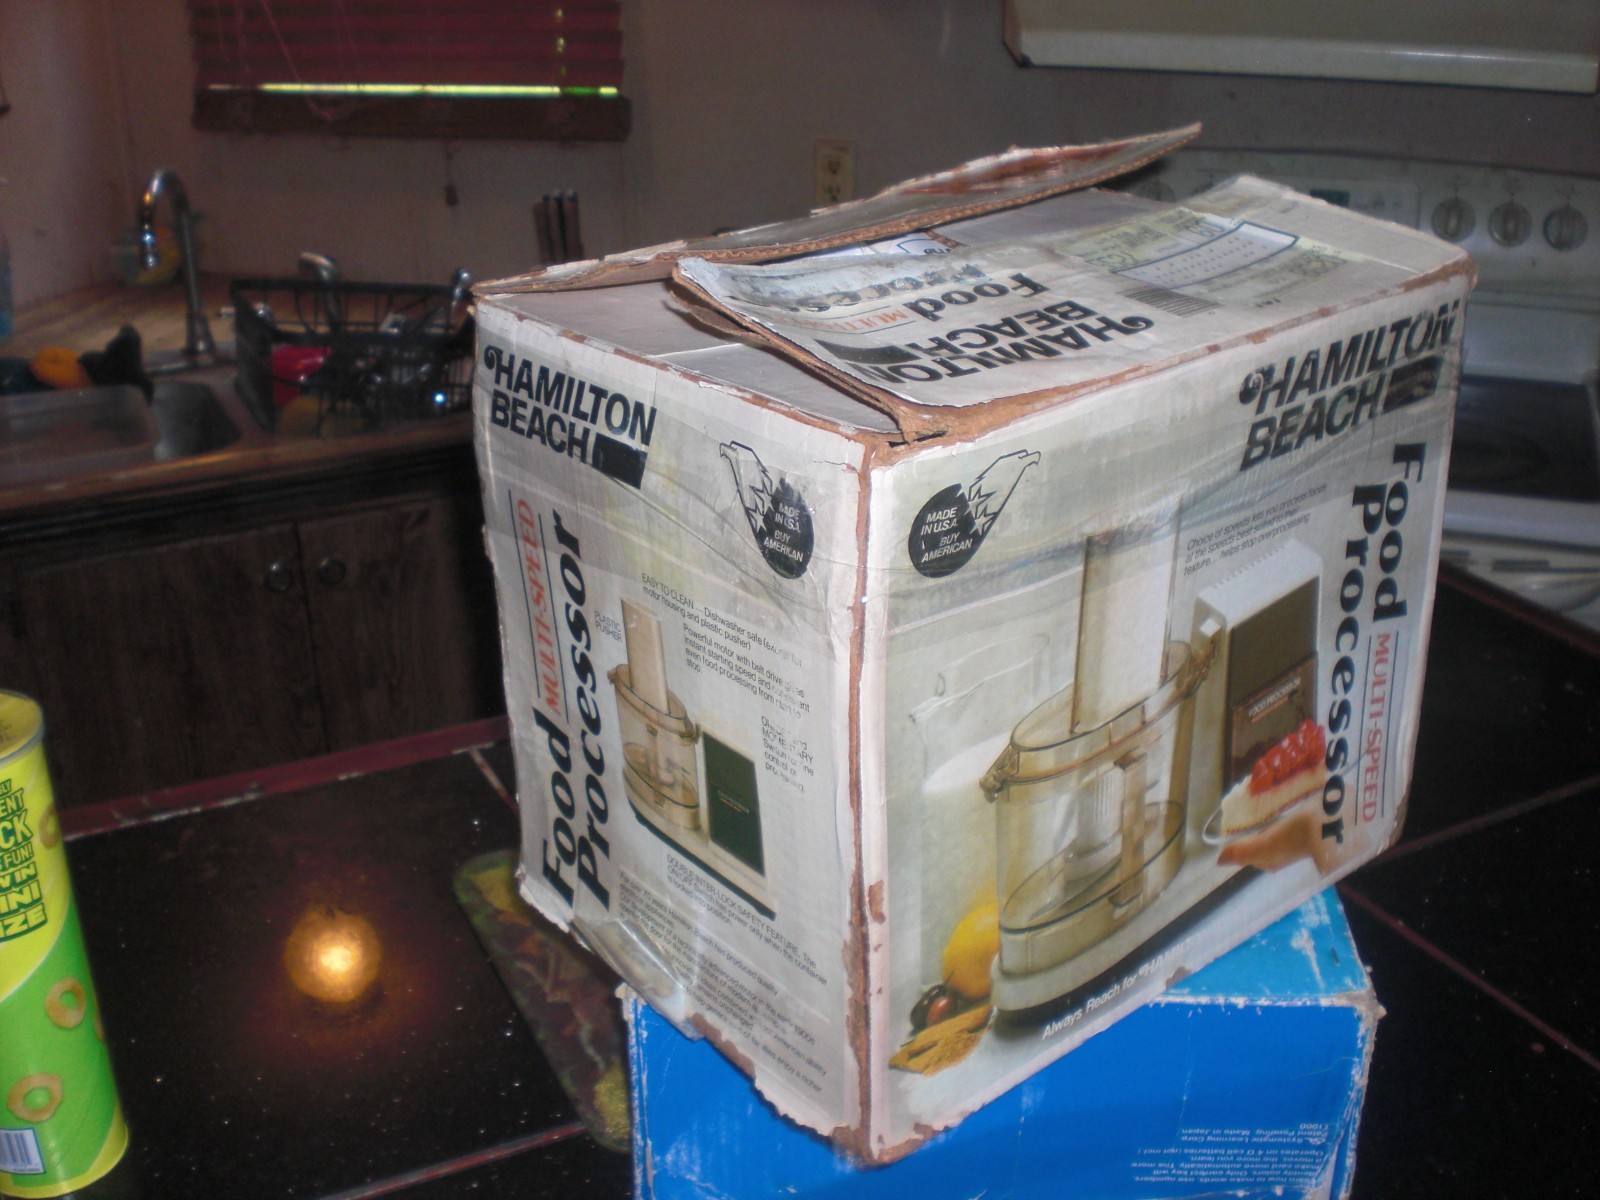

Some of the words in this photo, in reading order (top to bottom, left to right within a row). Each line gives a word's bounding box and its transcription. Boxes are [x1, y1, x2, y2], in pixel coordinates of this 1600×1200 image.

[902, 273, 1050, 321] Food
[846, 316, 1154, 382] HAMILTON
[905, 300, 1098, 356] BEACH
[1239, 300, 1460, 415] HAMILTON
[484, 345, 657, 446] HAMILTON
[1239, 368, 1386, 472] BEACH
[490, 388, 591, 465] BEACH
[774, 530, 790, 543] BUY
[775, 512, 784, 524] IN
[921, 525, 932, 536] IN
[926, 507, 957, 523] MADE
[940, 532, 960, 547] BUY
[1188, 532, 1214, 551] Choice
[1223, 516, 1251, 536] speeds
[1373, 443, 1426, 623] Food
[764, 536, 804, 562] AMERICAN
[921, 539, 973, 563] AMERICAN
[518, 499, 561, 716] MULTI-SPEED
[594, 610, 622, 633] PLASTIC
[595, 620, 623, 643] PUSHER
[641, 573, 660, 588] EASY
[660, 582, 670, 596] TO
[670, 589, 694, 609] CLEAN
[704, 607, 746, 636] Dishwasher
[747, 631, 763, 646] safe
[642, 585, 661, 601] motor
[661, 596, 686, 619] housing
[687, 610, 700, 624] and
[700, 618, 723, 637] plastic
[725, 631, 752, 651] pusher)
[683, 622, 713, 647] Powerful
[714, 641, 735, 657] motor
[736, 653, 751, 668] with
[752, 660, 764, 675] belt
[766, 669, 783, 686] drive
[684, 634, 706, 654] instant
[707, 649, 734, 671] starting
[735, 664, 757, 682] speed
[758, 677, 771, 691] and
[685, 647, 701, 662] even
[702, 655, 718, 672] food
[720, 665, 758, 696] processing
[759, 685, 775, 705] from
[1321, 482, 1388, 844] Processor
[553, 508, 609, 911] Processor
[1361, 633, 1391, 823] MULTI-SPEED
[533, 706, 576, 907] Food
[4, 842, 33, 869] FUN!
[727, 906, 749, 929] power
[749, 923, 763, 940] only
[794, 958, 828, 986] container
[737, 905, 766, 930] SAFETY
[802, 952, 817, 969] The
[726, 953, 757, 980] produced
[1042, 1008, 1083, 1040] Always
[1086, 983, 1121, 1014] Reach
[1122, 973, 1138, 991] for
[1251, 1136, 1303, 1144] Systematic
[1256, 1129, 1295, 1137] Pending
[1280, 1149, 1324, 1157] Operates
